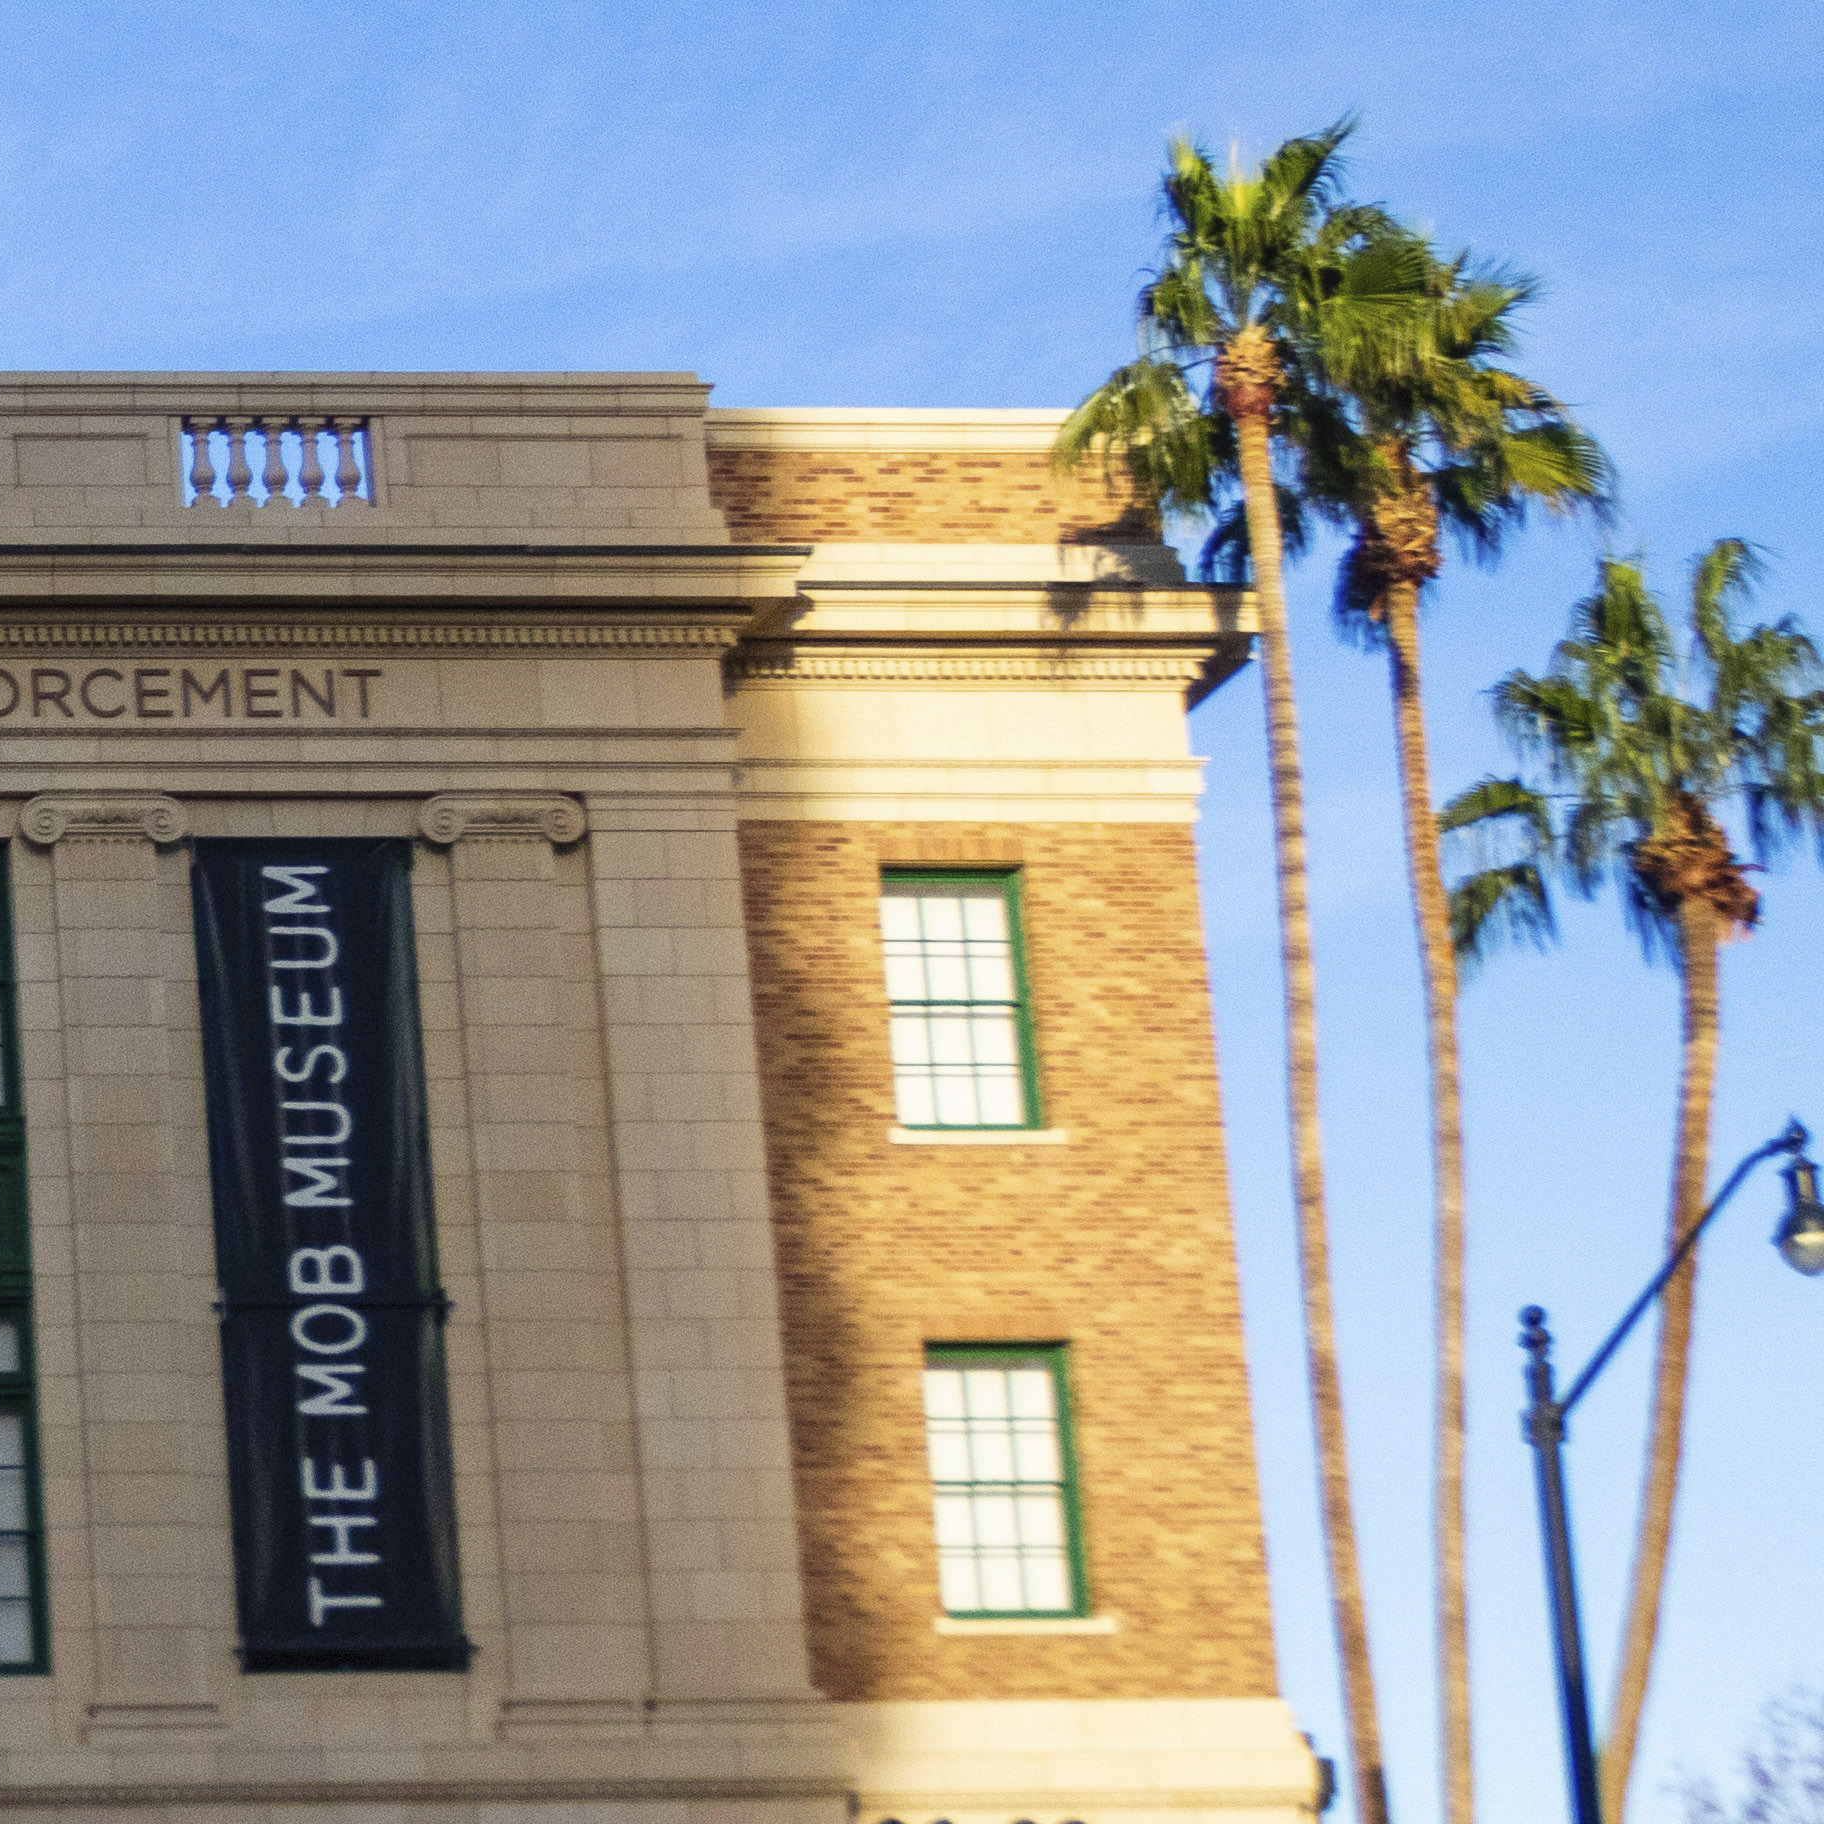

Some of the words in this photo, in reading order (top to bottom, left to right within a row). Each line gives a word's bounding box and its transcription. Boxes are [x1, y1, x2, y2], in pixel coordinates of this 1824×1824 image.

[260, 865, 354, 1208] MUSEUM
[287, 1244, 367, 1416] MOB
[300, 1456, 384, 1627] THE
